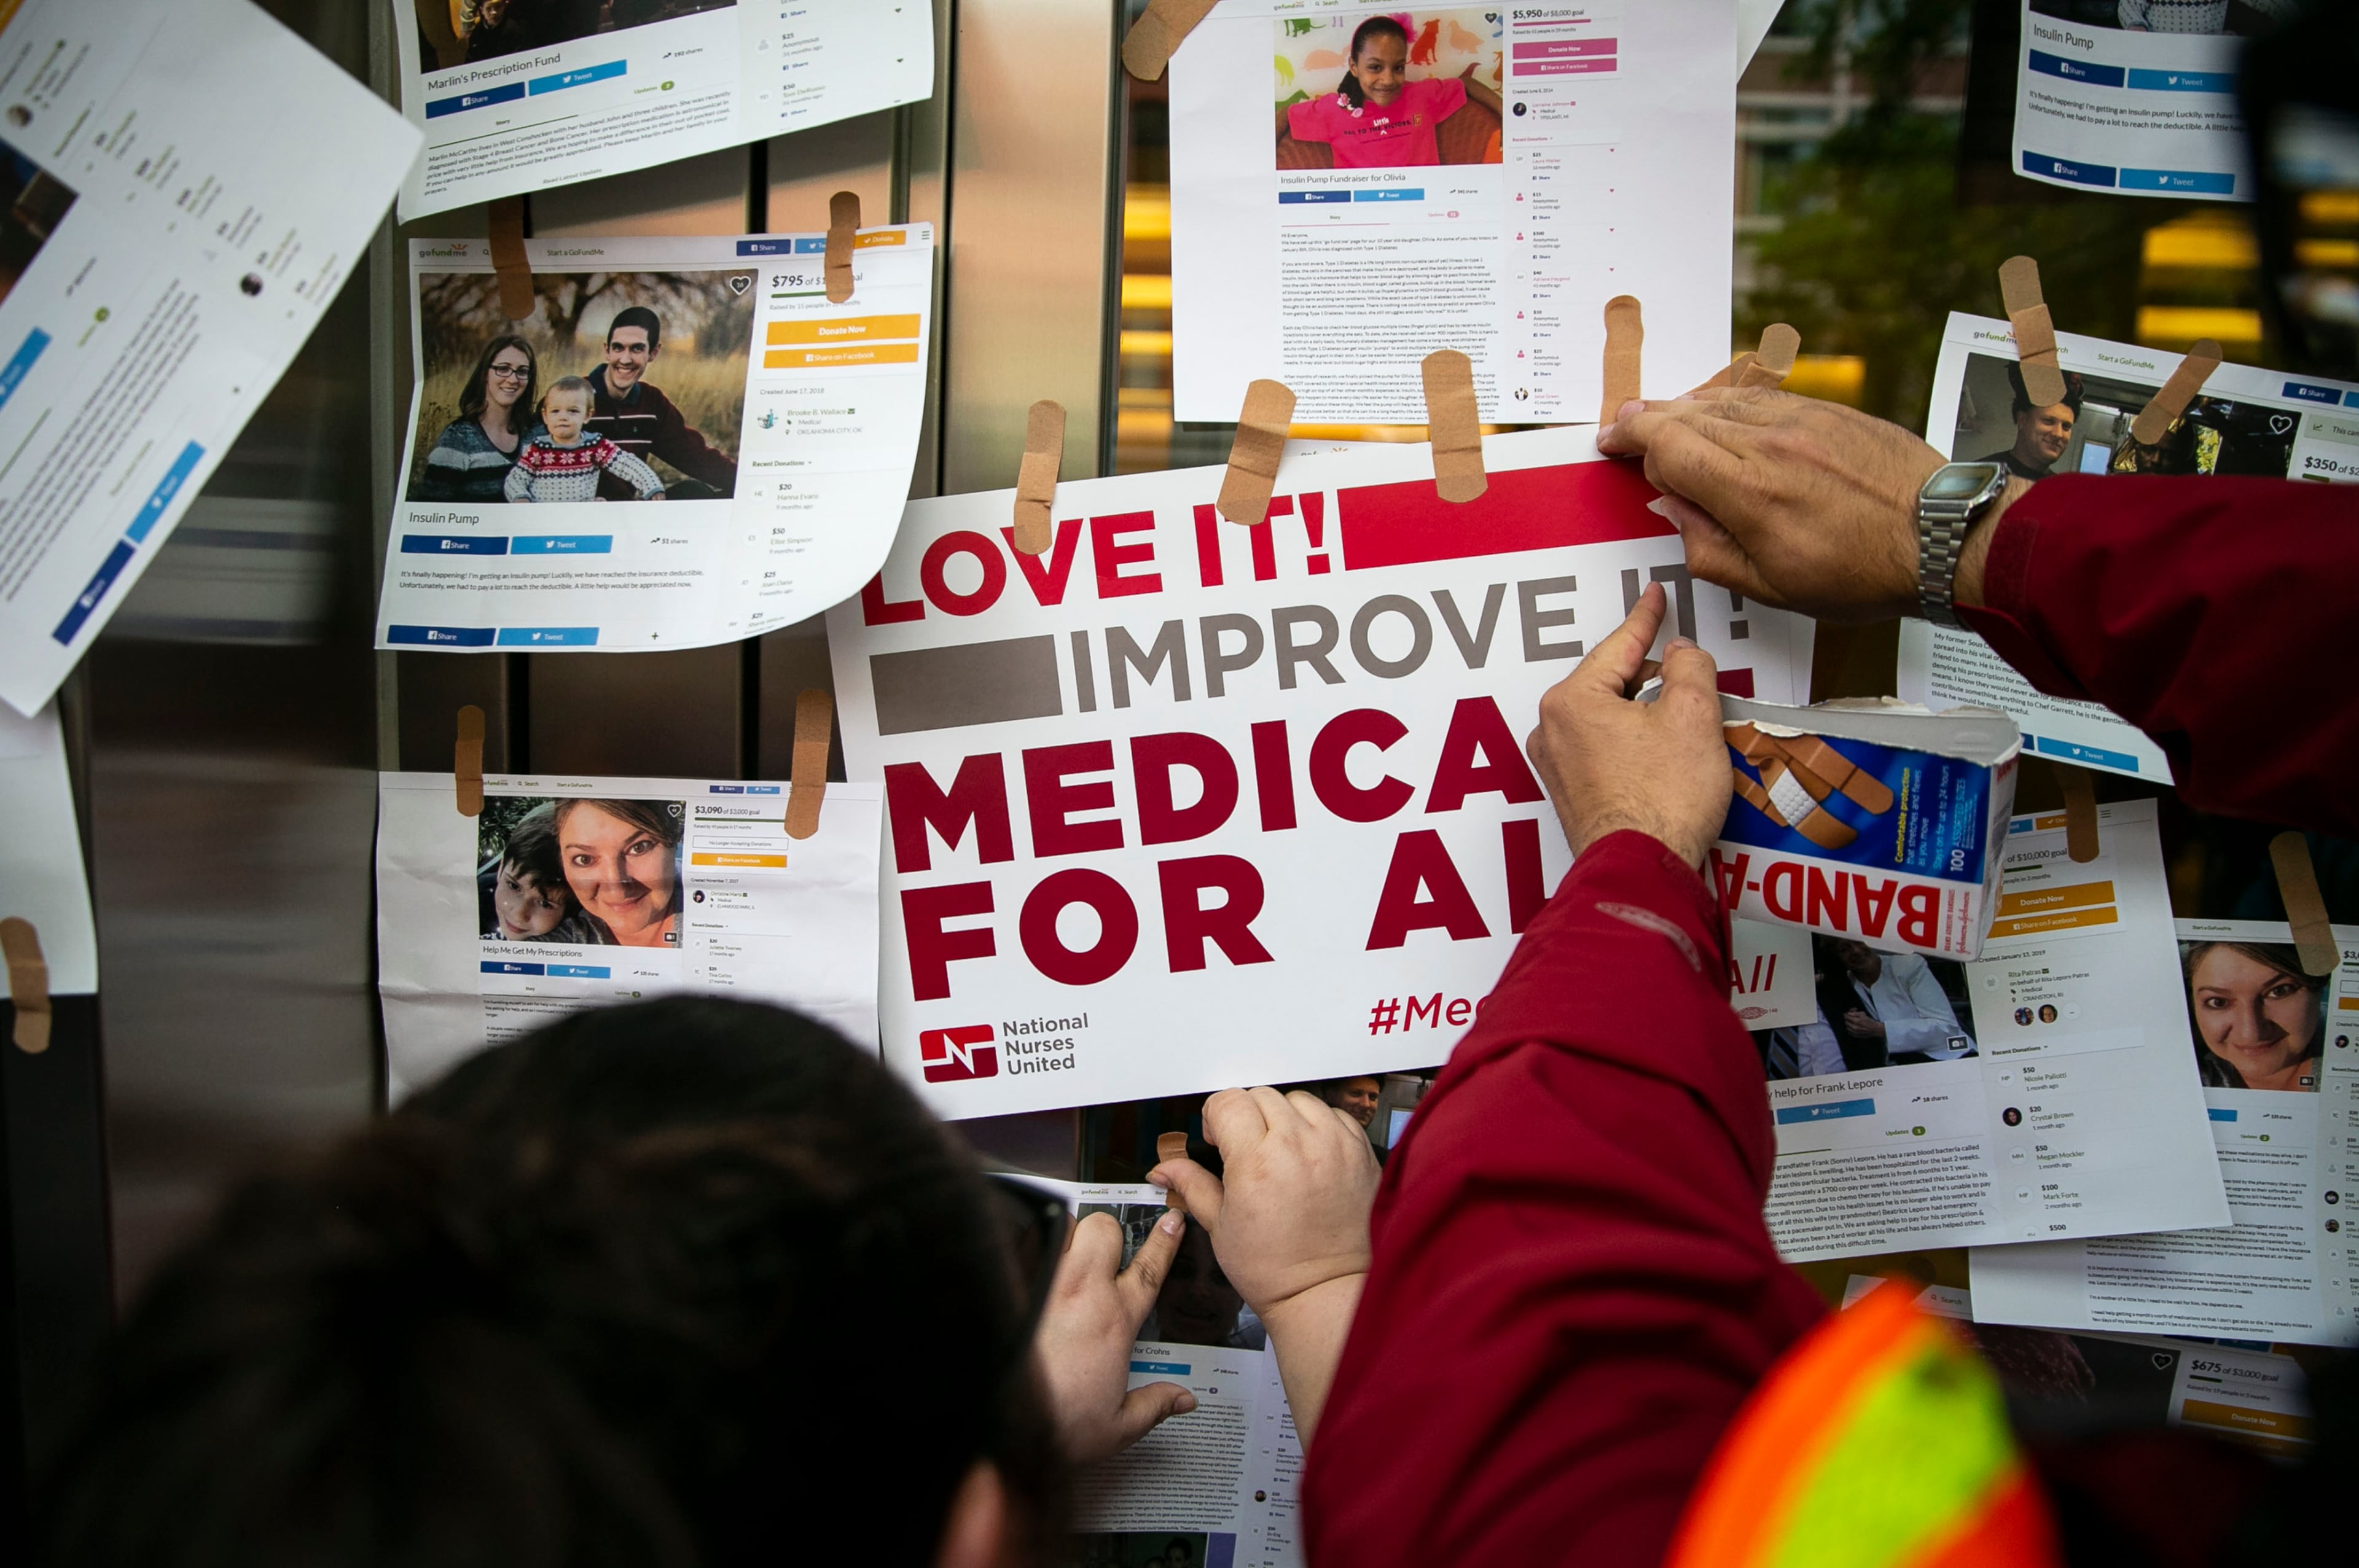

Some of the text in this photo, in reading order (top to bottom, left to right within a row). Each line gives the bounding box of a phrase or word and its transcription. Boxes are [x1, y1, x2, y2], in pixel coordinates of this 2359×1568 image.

[1513, 9, 1543, 19] $5,950
[2033, 23, 2094, 51] Insulin Pump
[428, 53, 561, 90] Marlin's Prescription Fund
[574, 71, 592, 81] Tweet
[2068, 66, 2086, 77] Share
[471, 94, 489, 104] Share
[2062, 166, 2078, 176] Share
[1280, 175, 1305, 184] Insulin
[1307, 175, 1329, 185] Pump
[1329, 174, 1369, 183] Fundraiser
[2173, 177, 2194, 186] Tweet
[419, 249, 467, 258] gofundme
[772, 275, 804, 287] $795
[818, 327, 847, 335] Donate
[2307, 389, 2326, 399] Share
[2304, 456, 2349, 474] $350 of
[410, 512, 479, 526] Insulin Pump
[861, 491, 1332, 626] LOVE IT!
[1070, 575, 1583, 712] IMPROVE
[1935, 633, 1983, 648] My former Sous
[2084, 751, 2103, 760] Tweet
[883, 668, 1755, 873] MEDICA
[695, 805, 722, 815] $3,090
[1895, 767, 1910, 863] Comfortable protection
[1933, 765, 1949, 869] Stays on for up to 24 hours
[1909, 812, 1919, 847] stretches
[1950, 778, 1966, 872] 100 ASSORTED SIZES
[2017, 850, 2050, 862] $10,000
[2051, 848, 2068, 859] goal
[1919, 858, 1926, 867] as
[901, 819, 1554, 1001] FOR AL
[483, 946, 499, 955] Help
[526, 948, 537, 957] My
[538, 950, 582, 958] Prescriptions
[1003, 1013, 1089, 1036] National
[1006, 1037, 1074, 1056] Nurses
[1007, 1053, 1076, 1075] United
[1775, 1078, 1883, 1099] help for Frank Lepore
[2031, 1114, 2053, 1123] Crystal
[1885, 1128, 1909, 1136] Updates
[1146, 1348, 1170, 1356] Crohns
[2191, 1359, 2221, 1373] $675
[2232, 1368, 2261, 1379] $3,000
[2261, 1373, 2279, 1382] goal
[2232, 1413, 2277, 1426] Donate Now
